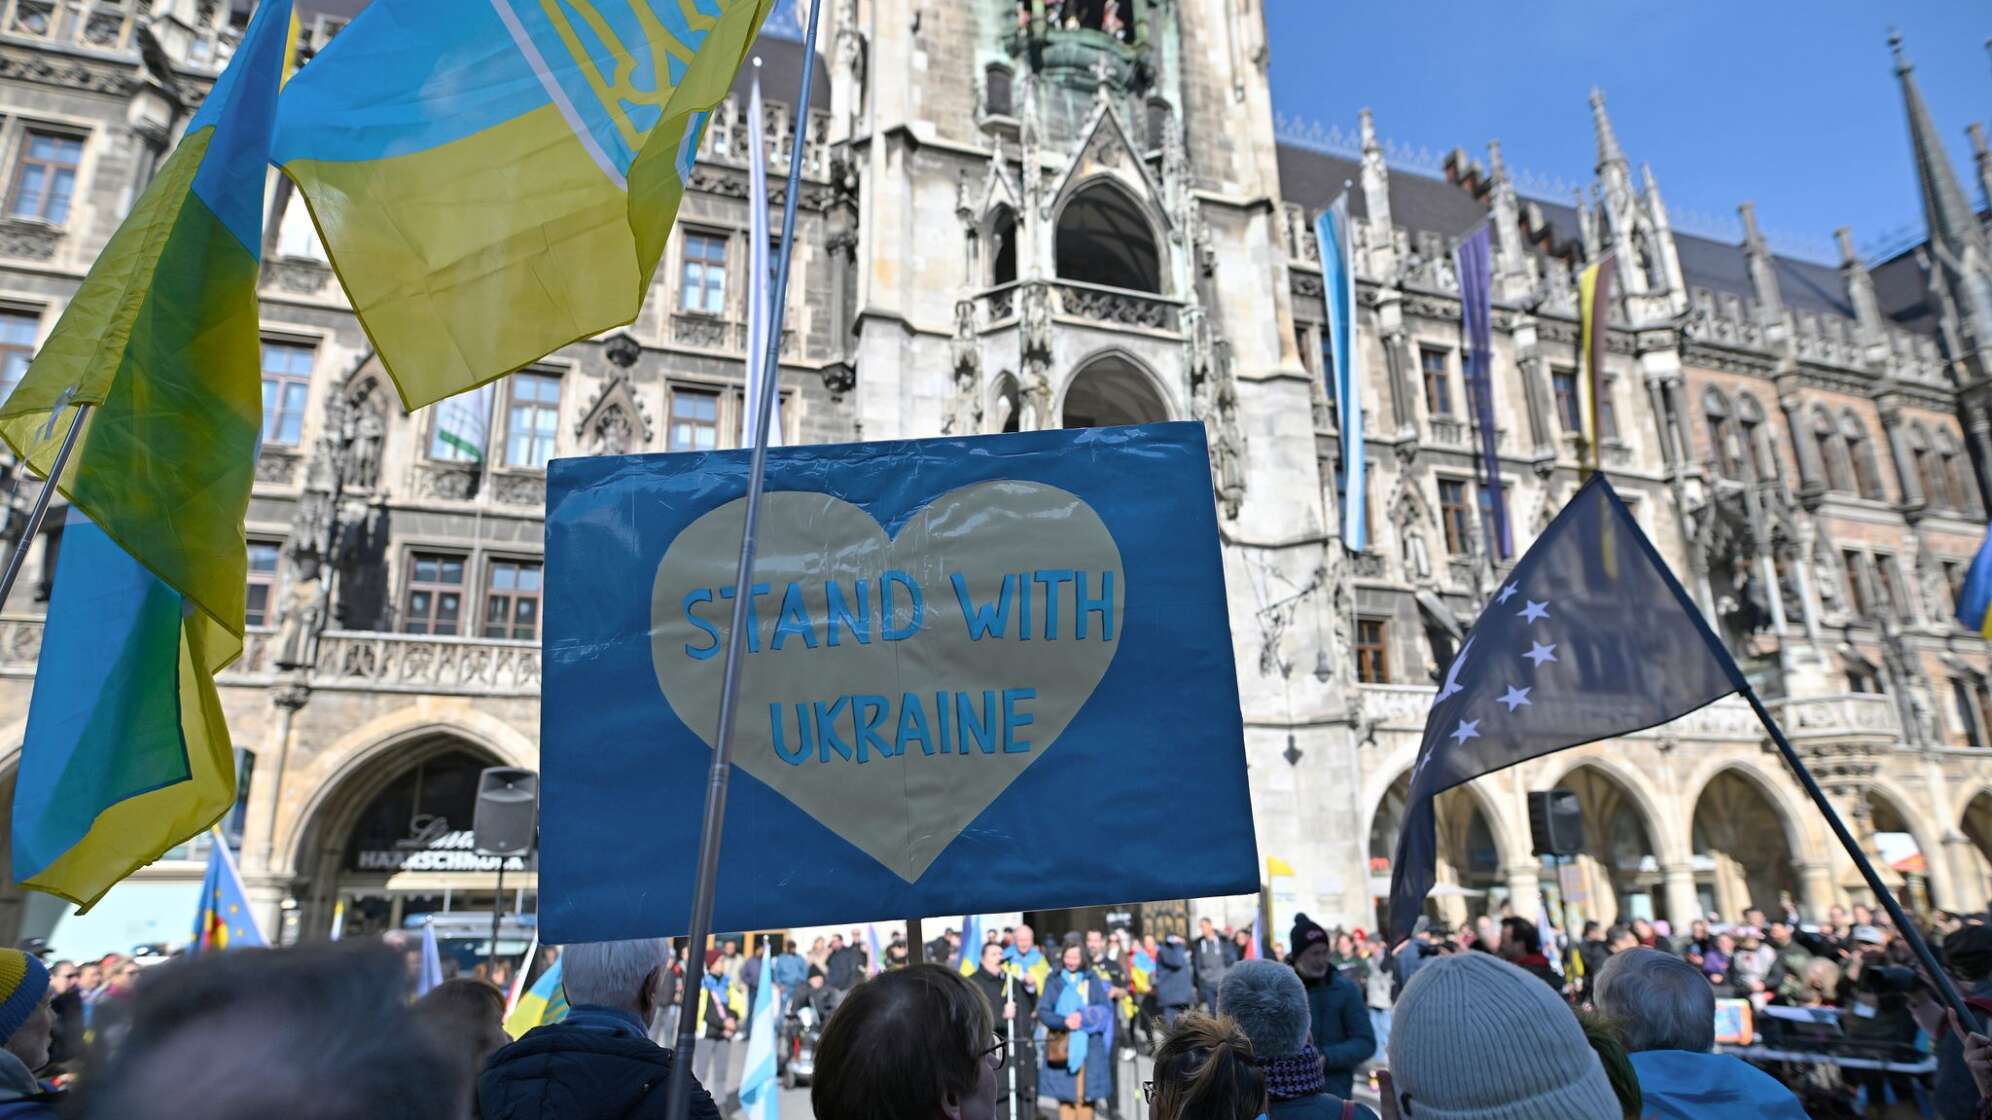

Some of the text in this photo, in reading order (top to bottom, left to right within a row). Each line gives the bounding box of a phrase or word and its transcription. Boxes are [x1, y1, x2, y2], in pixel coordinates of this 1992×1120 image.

[682, 569, 1115, 661] STAND WITH
[769, 688, 1037, 766] UKRAINE
